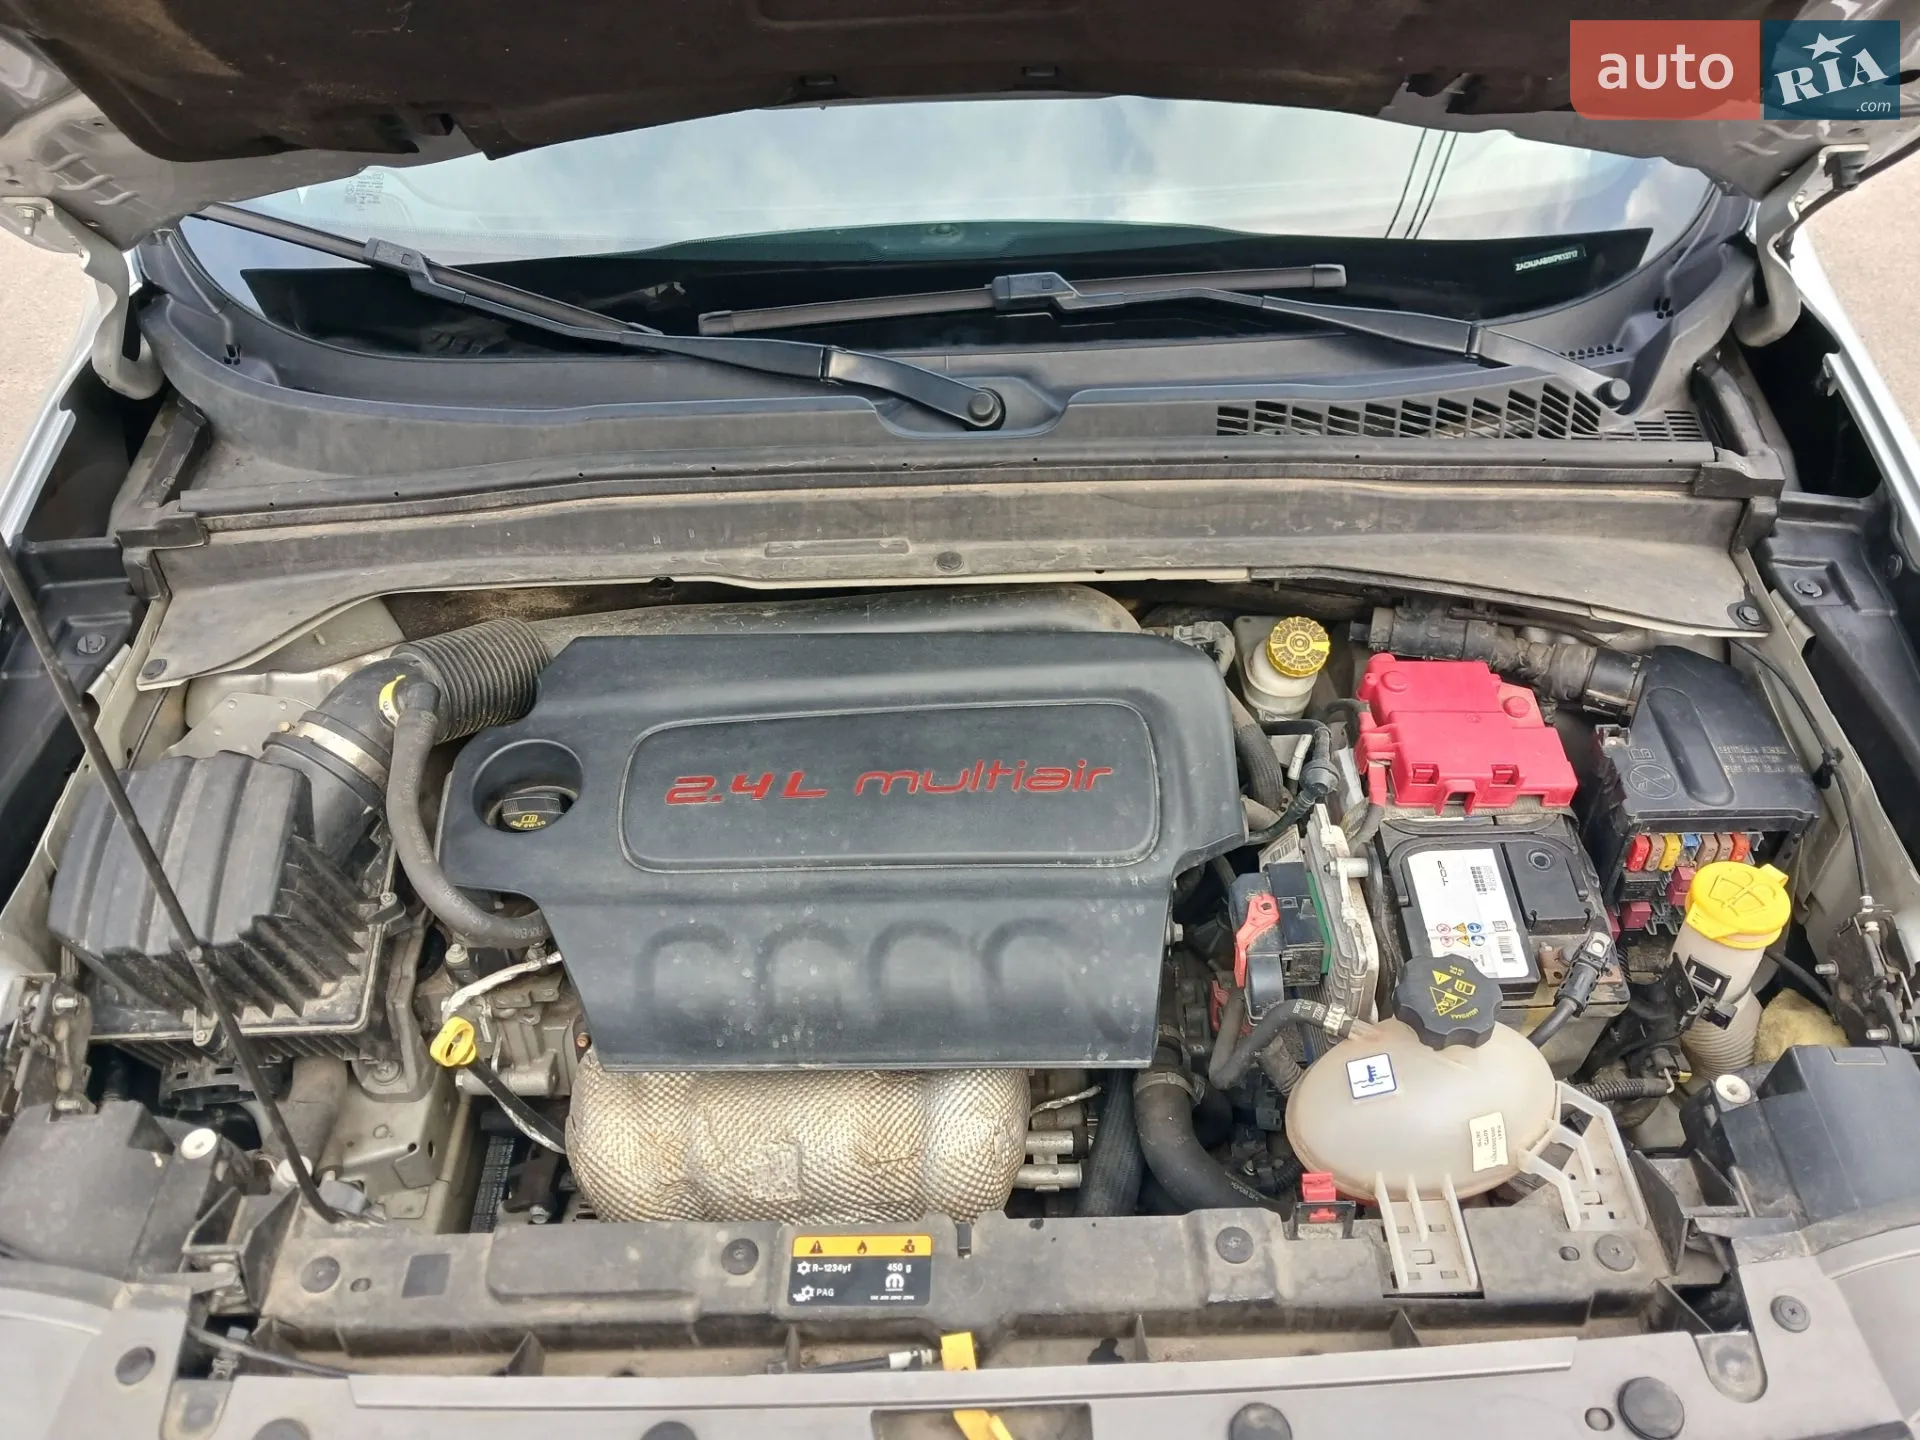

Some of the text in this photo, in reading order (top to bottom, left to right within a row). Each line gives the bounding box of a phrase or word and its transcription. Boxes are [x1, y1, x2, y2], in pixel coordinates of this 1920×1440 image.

[855, 758, 1114, 797] multiair
[812, 1263, 852, 1274] R-1234yf
[887, 1262, 903, 1272] 450
[816, 1288, 835, 1297] PAG
